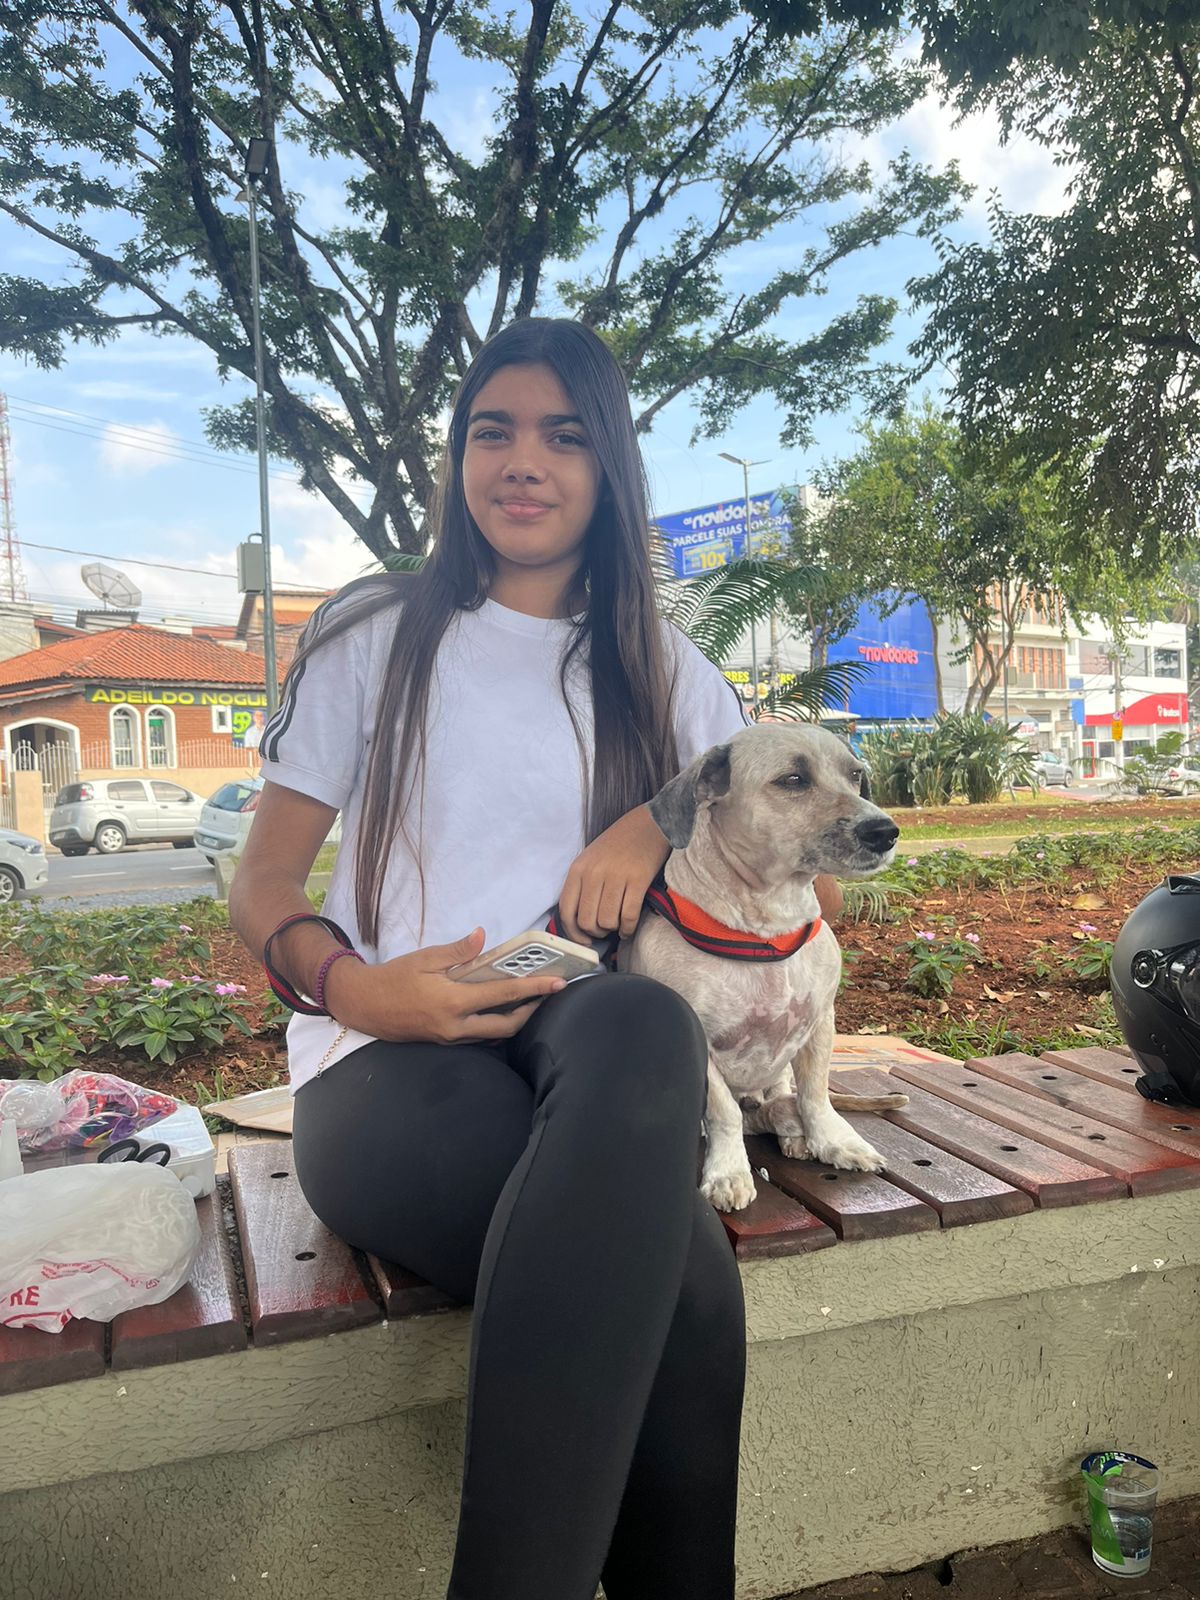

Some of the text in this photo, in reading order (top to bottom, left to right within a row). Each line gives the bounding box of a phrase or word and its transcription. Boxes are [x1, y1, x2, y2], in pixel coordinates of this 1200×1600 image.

[673, 531, 715, 547] PARCELE
[717, 523, 743, 538] SUAS
[91, 688, 195, 705] ADEILDO
